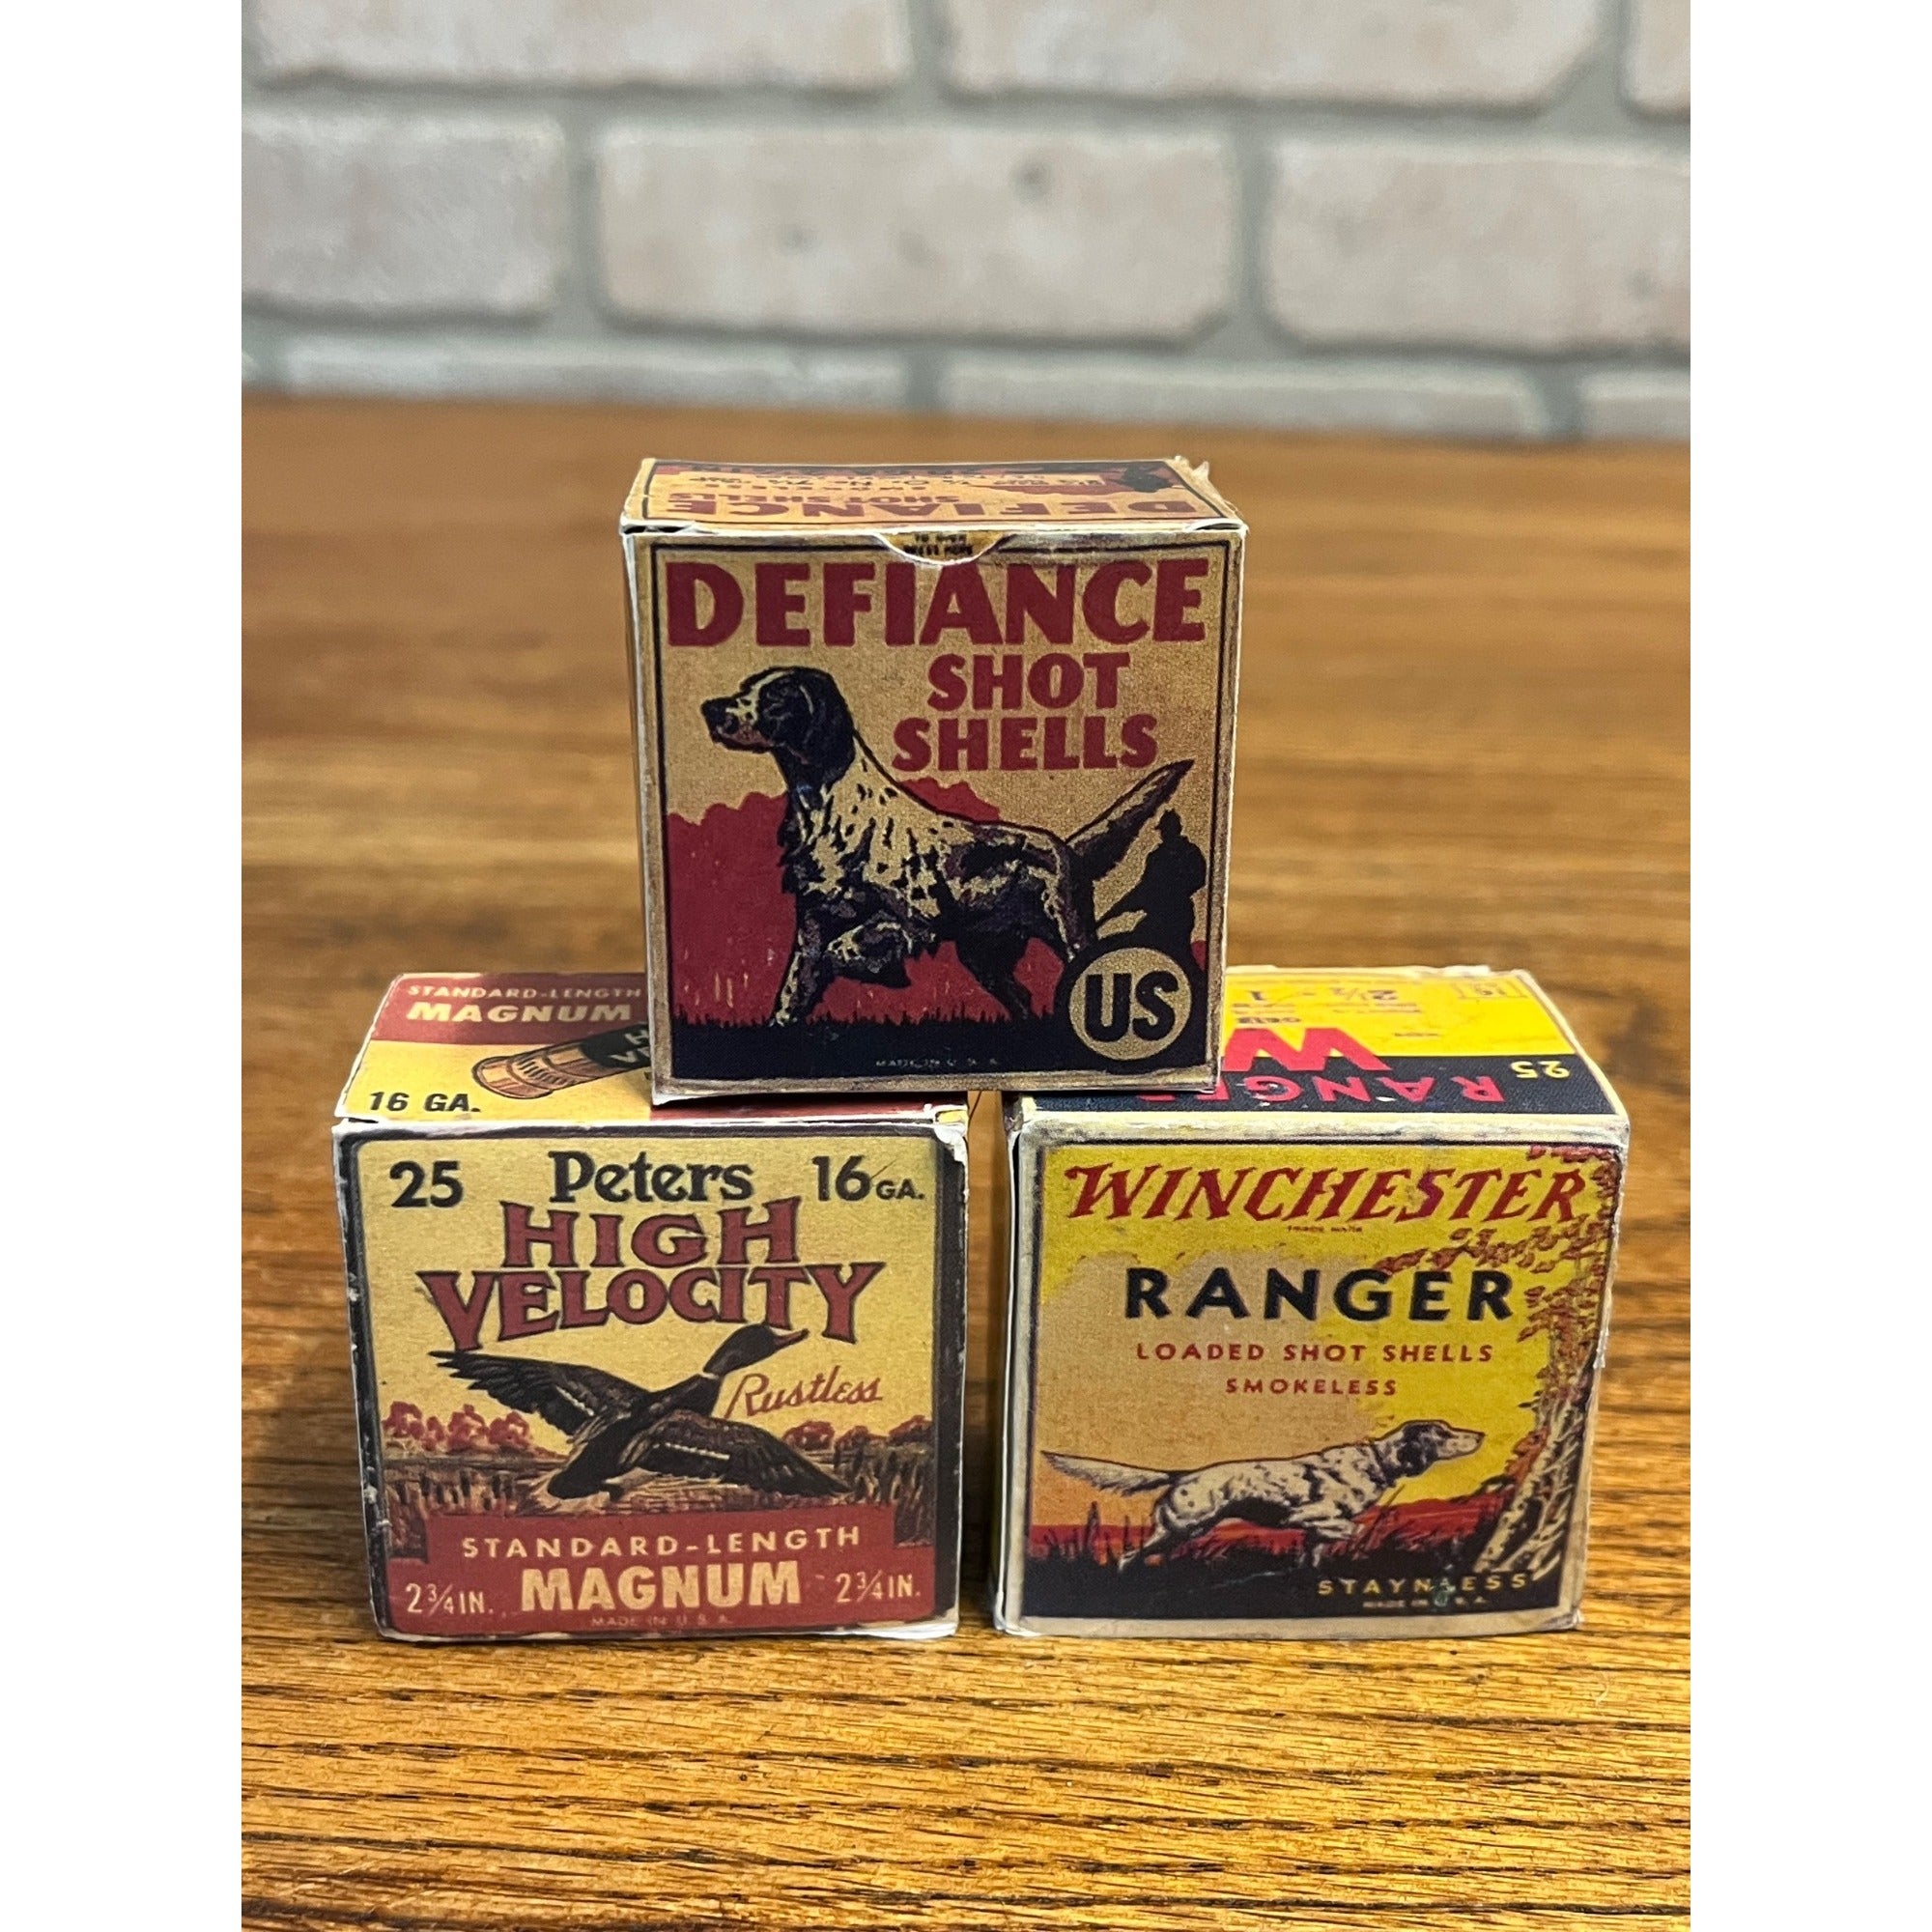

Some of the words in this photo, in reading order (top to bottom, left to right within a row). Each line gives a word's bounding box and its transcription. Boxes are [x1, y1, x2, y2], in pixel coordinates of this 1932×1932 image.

[667, 499, 1197, 517] DEFIANCE
[665, 558, 1209, 646] DEFIANCE
[927, 651, 1130, 711] SHOT
[893, 714, 1157, 772] SHELLS
[407, 984, 642, 999] STANDARD-LENGTH
[407, 1002, 632, 1023] MAGNUM
[1085, 971, 1179, 1042] US
[1510, 1060, 1572, 1080] 25
[369, 1092, 410, 1112] 16
[423, 1093, 481, 1113] GA.
[389, 1160, 464, 1208] 25
[549, 1151, 754, 1205] Peters
[1065, 1162, 1587, 1223] WINCHESTER
[500, 1197, 803, 1268] HIGH
[415, 1262, 888, 1352] VELOCITY
[1123, 1267, 1515, 1322] RANGER
[1136, 1343, 1264, 1363] LOADED
[1283, 1342, 1369, 1363] SHOT
[1381, 1343, 1495, 1363] SHELLS
[724, 1365, 883, 1419] Rustless
[1224, 1378, 1399, 1397] SMOKELESS
[462, 1526, 862, 1559] STANDARD-LENGTH
[521, 1560, 803, 1612] MAGNUM
